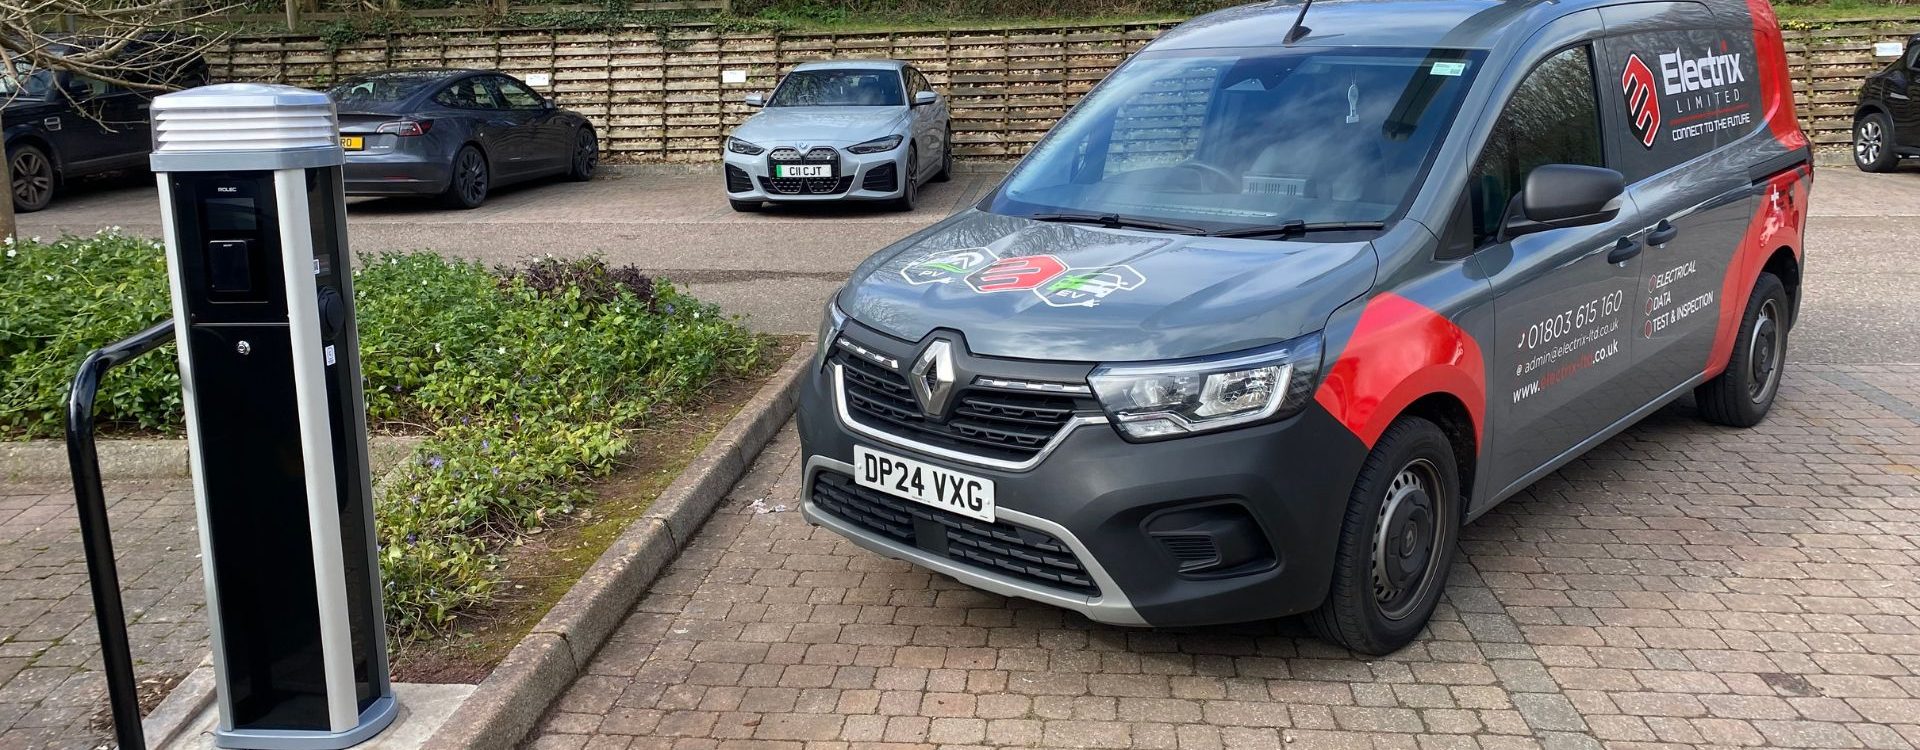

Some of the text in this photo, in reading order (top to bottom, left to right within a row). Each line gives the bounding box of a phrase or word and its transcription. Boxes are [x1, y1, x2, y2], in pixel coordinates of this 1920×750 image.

[1659, 39, 1745, 95] Electrix
[1676, 88, 1740, 113] LIMITED
[1672, 113, 1751, 141] CONNECT TO THE FUTURE
[803, 167, 822, 176] CJT
[1656, 260, 1696, 289] ELECTRICAL
[1056, 290, 1086, 299] EV
[1653, 291, 1672, 311] DATA
[1528, 289, 1623, 349] 01803 615 160
[1653, 290, 1714, 333] TEST & INSPECTION
[1524, 318, 1619, 374] admin@electrix-ltd.co.uk
[864, 452, 983, 512] DP24 VXG
